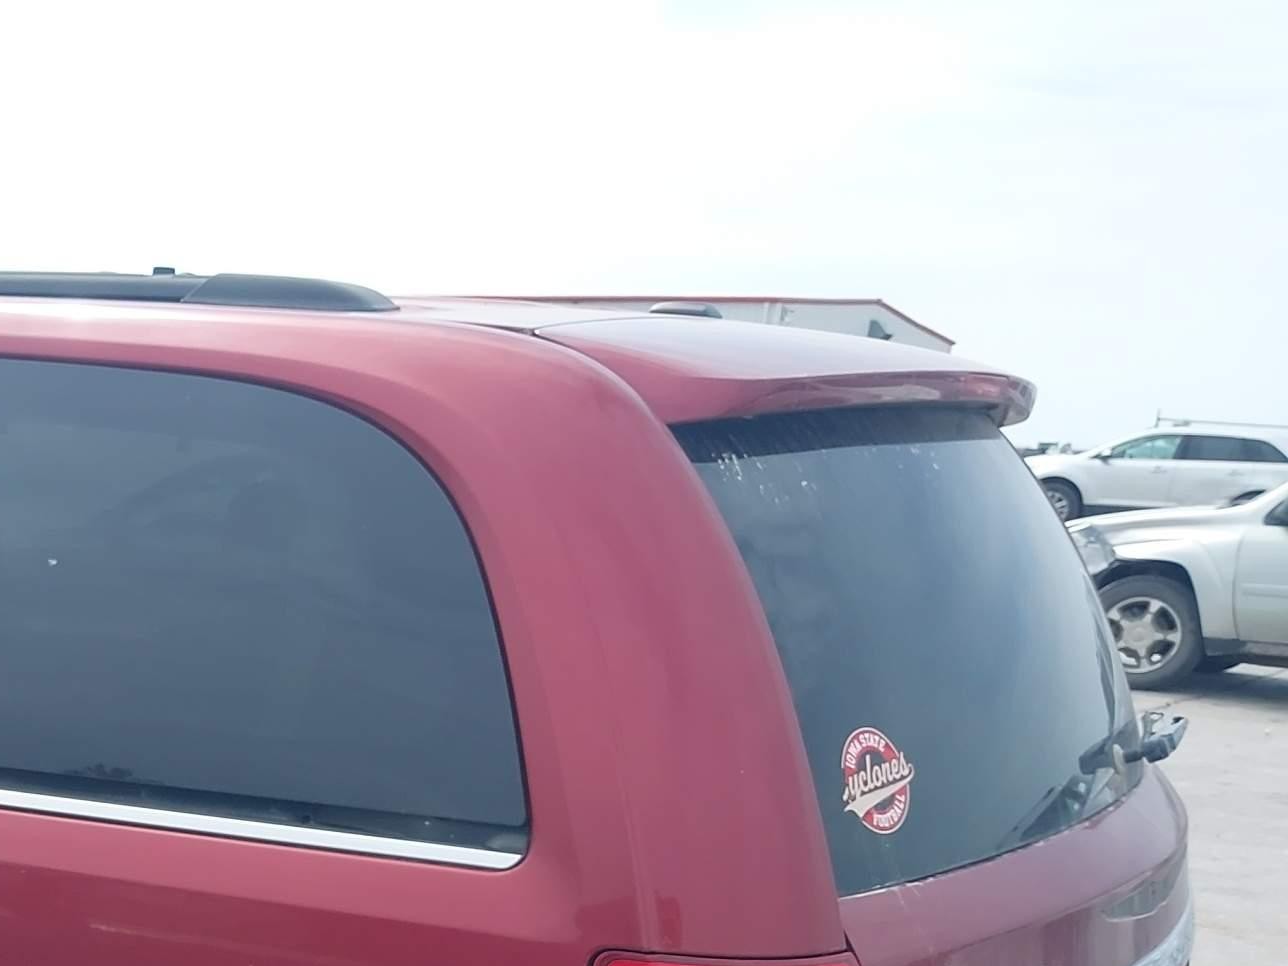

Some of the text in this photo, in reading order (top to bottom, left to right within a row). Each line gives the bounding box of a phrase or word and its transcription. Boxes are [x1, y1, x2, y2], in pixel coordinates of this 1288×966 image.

[844, 732, 887, 769] IOWA STATE
[872, 793, 906, 838] FOOTBALL
